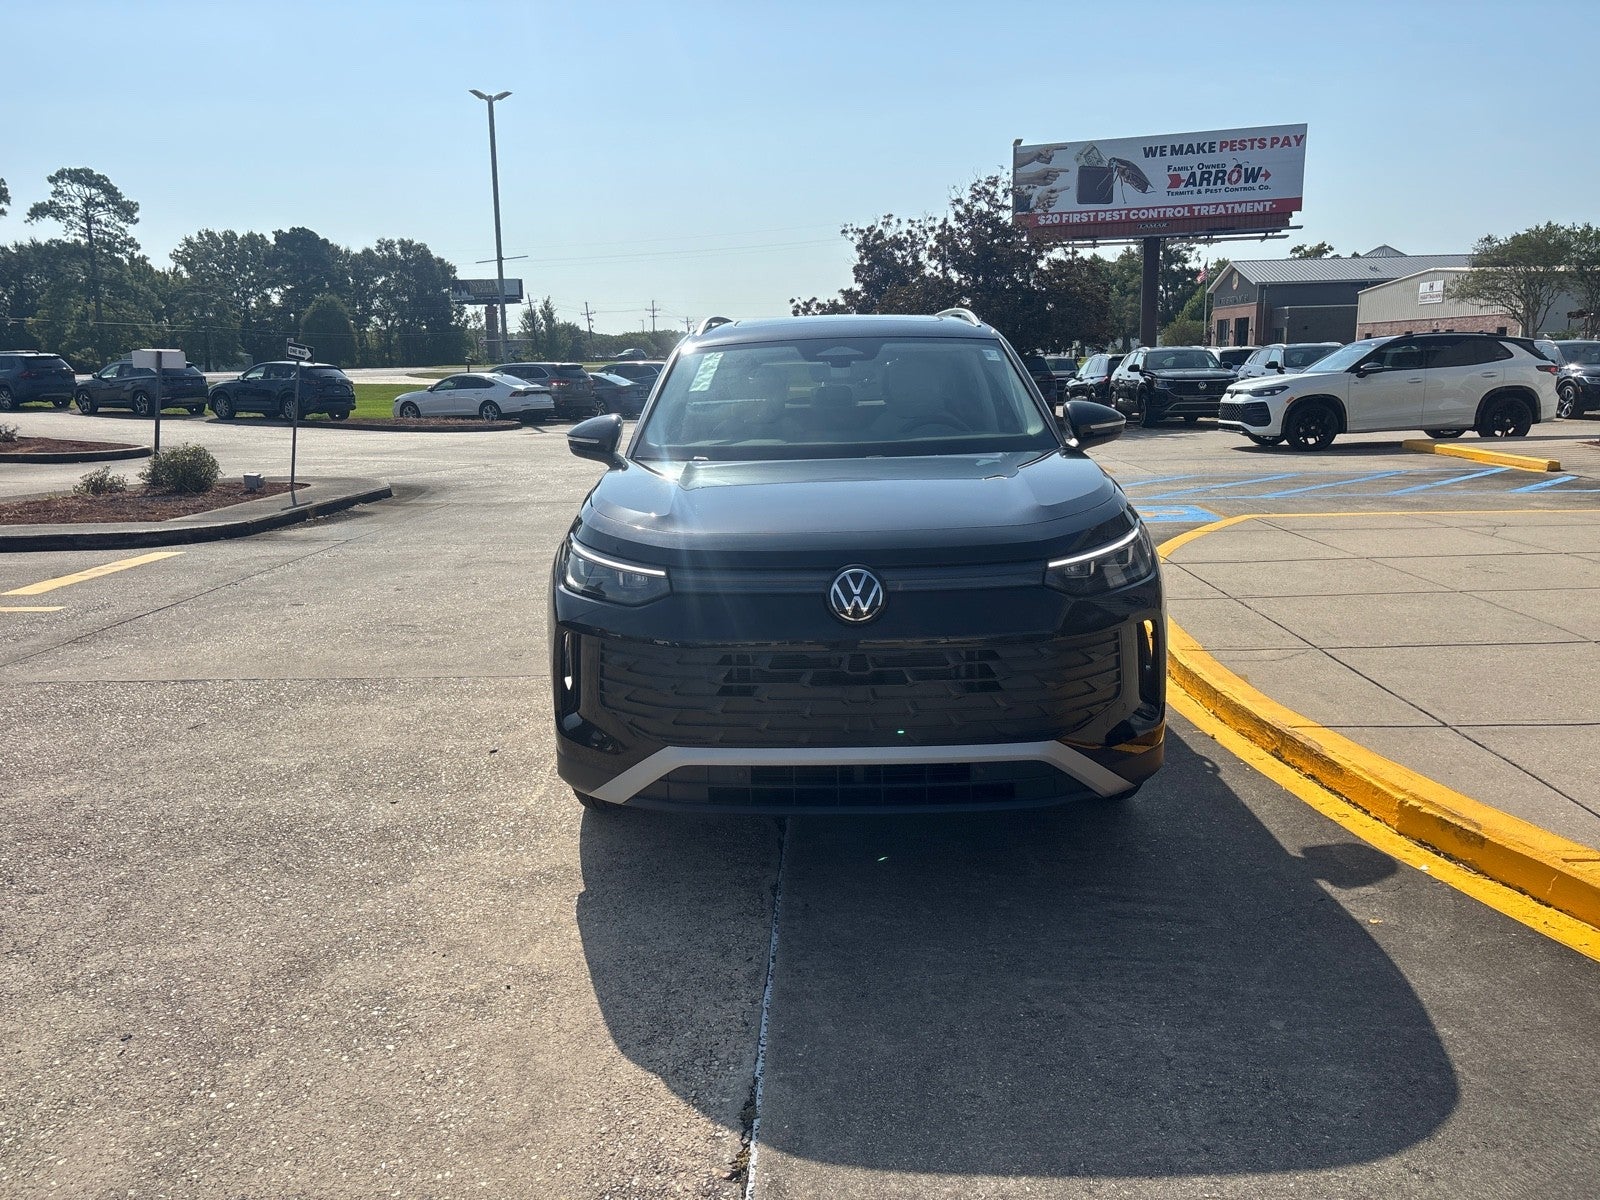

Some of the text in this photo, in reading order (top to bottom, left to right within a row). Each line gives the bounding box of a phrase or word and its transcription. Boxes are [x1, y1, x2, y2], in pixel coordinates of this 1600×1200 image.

[1143, 134, 1305, 158] WE MAKE PESTS PAY
[1167, 162, 1227, 172] FAMILY OWNED
[1183, 166, 1263, 188] ARROW
[1224, 185, 1256, 193] CONTROL
[1037, 214, 1060, 225] $20
[1062, 212, 1097, 224] FIRST
[1097, 210, 1128, 222] PEST
[1129, 204, 1190, 220] CONTROL
